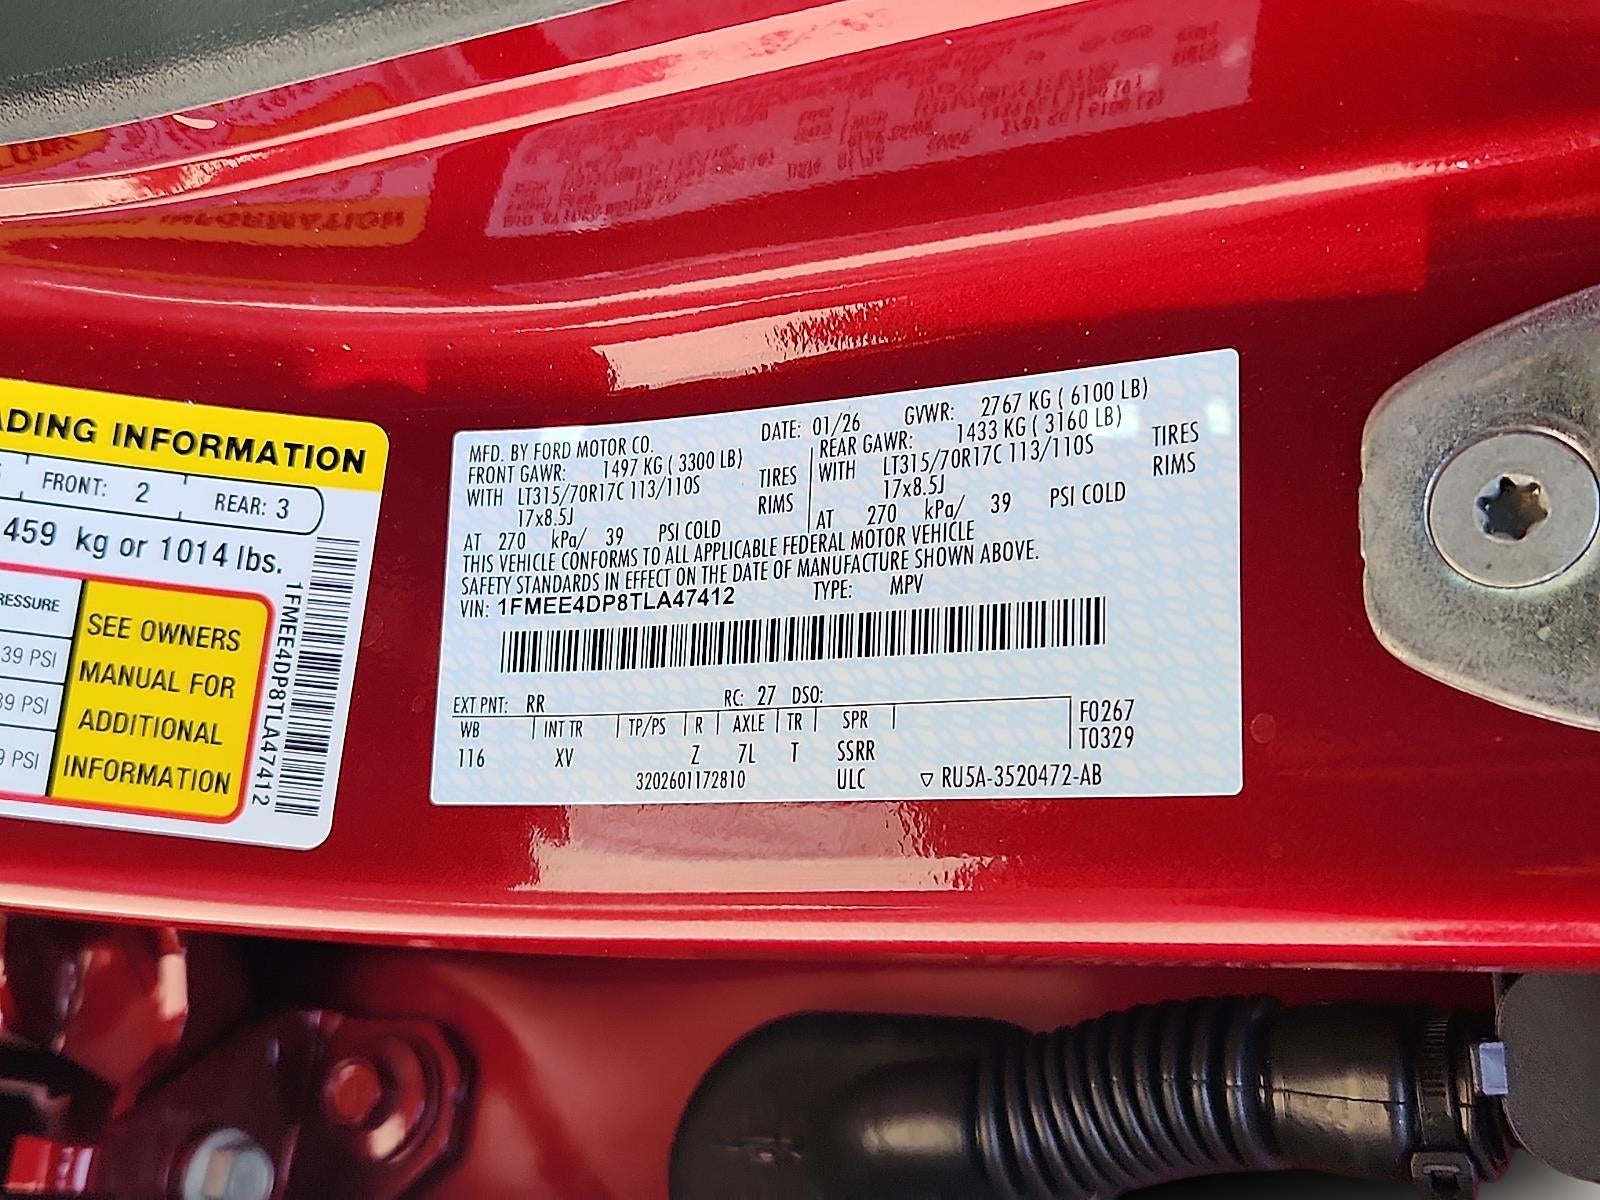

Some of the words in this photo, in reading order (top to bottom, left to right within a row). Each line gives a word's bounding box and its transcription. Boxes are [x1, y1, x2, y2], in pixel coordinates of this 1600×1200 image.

[905, 402, 954, 425] GVWR:
[981, 393, 1022, 417] 2767
[1030, 390, 1050, 410] KG
[1072, 382, 1113, 405] 6100
[1122, 377, 1147, 400] LB)
[762, 420, 800, 441] DATE:
[813, 412, 860, 437] 01/26
[820, 436, 856, 458] REAR
[863, 431, 912, 453] GAWR:
[958, 420, 997, 443] 1433
[1005, 416, 1026, 438] KG
[1045, 409, 1087, 433] 3160
[1096, 405, 1121, 428] LB)
[0, 408, 97, 444] DING
[113, 423, 366, 474] INFORMATION
[469, 445, 504, 462] MFD.
[511, 444, 528, 461] BY
[534, 442, 570, 460] FORD
[576, 438, 626, 458] MOTOR
[632, 436, 653, 454] CO.
[819, 460, 855, 482] WITH
[884, 444, 1002, 476] LT315/70R17C
[1010, 434, 1093, 462] 113/110S
[1152, 421, 1198, 446] TIRES
[469, 466, 515, 484] FRONT
[521, 464, 565, 482] GAWR:
[604, 458, 638, 478] 1497
[644, 456, 662, 475] KG
[679, 451, 714, 472] 3300
[721, 448, 742, 469] LB)
[884, 474, 944, 499] 17x8.5J
[1154, 452, 1195, 476] RIMS
[42, 472, 106, 496] FRONT:
[136, 482, 148, 503] 2
[467, 488, 502, 506] WITH
[518, 482, 624, 506] LT315/70R17C
[632, 475, 700, 500] 113/110S
[759, 466, 796, 488] TIRES
[215, 493, 266, 515] REAR:
[276, 498, 289, 519] 3
[519, 507, 573, 527] 17x8.5J
[758, 493, 793, 515] RIMS
[816, 509, 834, 530] AT
[867, 504, 896, 525] 270
[925, 495, 965, 520] kPa/
[991, 492, 1010, 513] 39
[1051, 486, 1074, 508] PSI
[1083, 482, 1125, 504] COLD
[4, 517, 56, 546] 459
[76, 526, 108, 559] kg
[120, 538, 148, 558] or
[162, 536, 228, 567] 1014
[237, 546, 281, 574] lbs.
[463, 554, 493, 573] THIS
[500, 553, 556, 572] VEHICLE
[562, 548, 637, 570] CONFORMS
[643, 546, 660, 566] TO
[665, 545, 689, 564] ALL
[694, 537, 777, 562] APPLICABLE
[783, 532, 845, 555] FEDERAL
[851, 527, 905, 550] MOTOR
[912, 520, 974, 544] VEHICLE
[464, 533, 482, 551] AT
[498, 532, 525, 550] 270
[552, 528, 587, 550] kPa/
[606, 527, 623, 546] 39
[659, 523, 679, 542] PSI
[685, 520, 720, 540] COLD
[462, 576, 512, 595] SAFETY
[517, 572, 599, 594] STANDARDS
[605, 572, 619, 591] IN
[626, 568, 671, 589] EFFECT
[676, 566, 696, 586] ON
[702, 564, 727, 584] THE
[733, 561, 768, 582] DATE
[774, 559, 792, 579] OF
[797, 550, 909, 577] MANUFACTURE
[915, 544, 973, 568] SHOWN
[980, 539, 1038, 564] ABOVE.
[813, 579, 852, 600] TYPE:
[890, 574, 923, 595] MPV
[460, 600, 489, 618] VIN:
[498, 587, 734, 615] 1FMEE4DP8TLA47412
[88, 614, 132, 638] SEE
[141, 620, 240, 651] OWNERS
[2, 646, 23, 664] 39
[30, 649, 56, 667] PSI
[79, 660, 180, 692] MANUAL
[190, 673, 235, 698] FOR
[22, 696, 48, 714] PSI
[252, 582, 303, 805] 1FMEE4DP8TLA47412
[454, 696, 476, 713] EXT
[480, 697, 508, 713] PNT:
[527, 694, 544, 713] RR
[725, 689, 743, 707] RC:
[757, 685, 776, 705] 27
[793, 686, 823, 704] DSO:
[78, 709, 222, 745] ADDITIONAL
[461, 721, 479, 738] WB
[544, 720, 565, 738] INT
[569, 720, 582, 737] TR
[629, 716, 666, 737] TP/PS
[696, 717, 702, 734] R
[733, 714, 765, 732] AXLE
[787, 713, 802, 730] TR
[843, 710, 868, 729] SPR
[12, 750, 39, 769] PSI
[460, 749, 484, 767] 116
[555, 748, 574, 767] XV
[691, 745, 700, 764] Z
[739, 743, 755, 764] 7L
[791, 742, 799, 762] T
[838, 740, 875, 761] SSRR
[64, 755, 231, 794] INFORMATION
[636, 770, 745, 790] 3202601172810
[838, 768, 865, 789] ULC
[942, 764, 1101, 788] RU5A-3520472-AB
